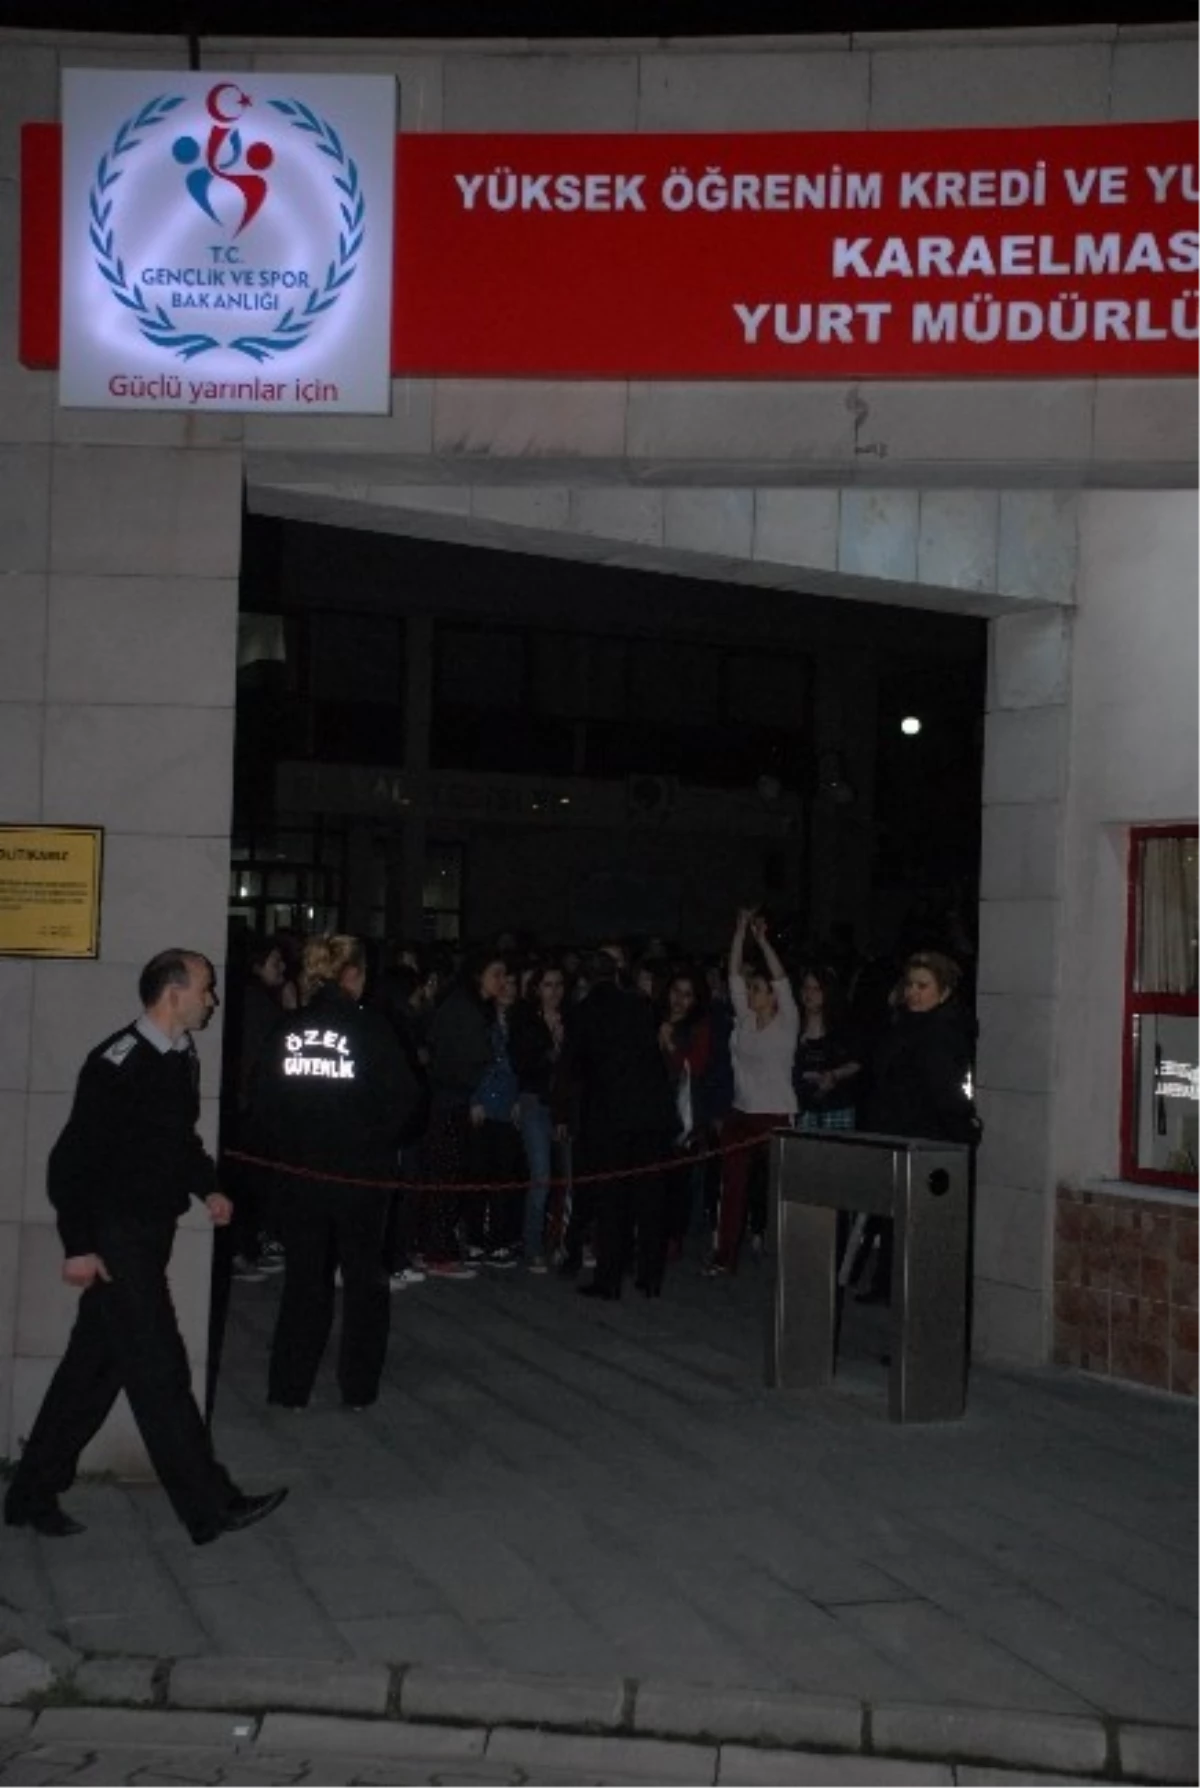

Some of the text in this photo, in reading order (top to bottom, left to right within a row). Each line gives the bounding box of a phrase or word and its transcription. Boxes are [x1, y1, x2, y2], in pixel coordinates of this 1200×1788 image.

[455, 168, 645, 211] YÜKSEK
[662, 166, 881, 211] ÖĞRENİM
[900, 161, 1045, 208] KREDİ
[1064, 167, 1127, 204] VE
[210, 246, 244, 264] T.C.
[833, 231, 1200, 277] KARAELMAS
[141, 268, 310, 289] GENÇLİK VE SPOR
[734, 290, 1200, 343] YURT MÜDÜRLÜ
[108, 374, 338, 404] Güçlü yarınlar için
[285, 1029, 351, 1056] ÖZEL
[283, 1055, 355, 1078] GÜVENLİK
